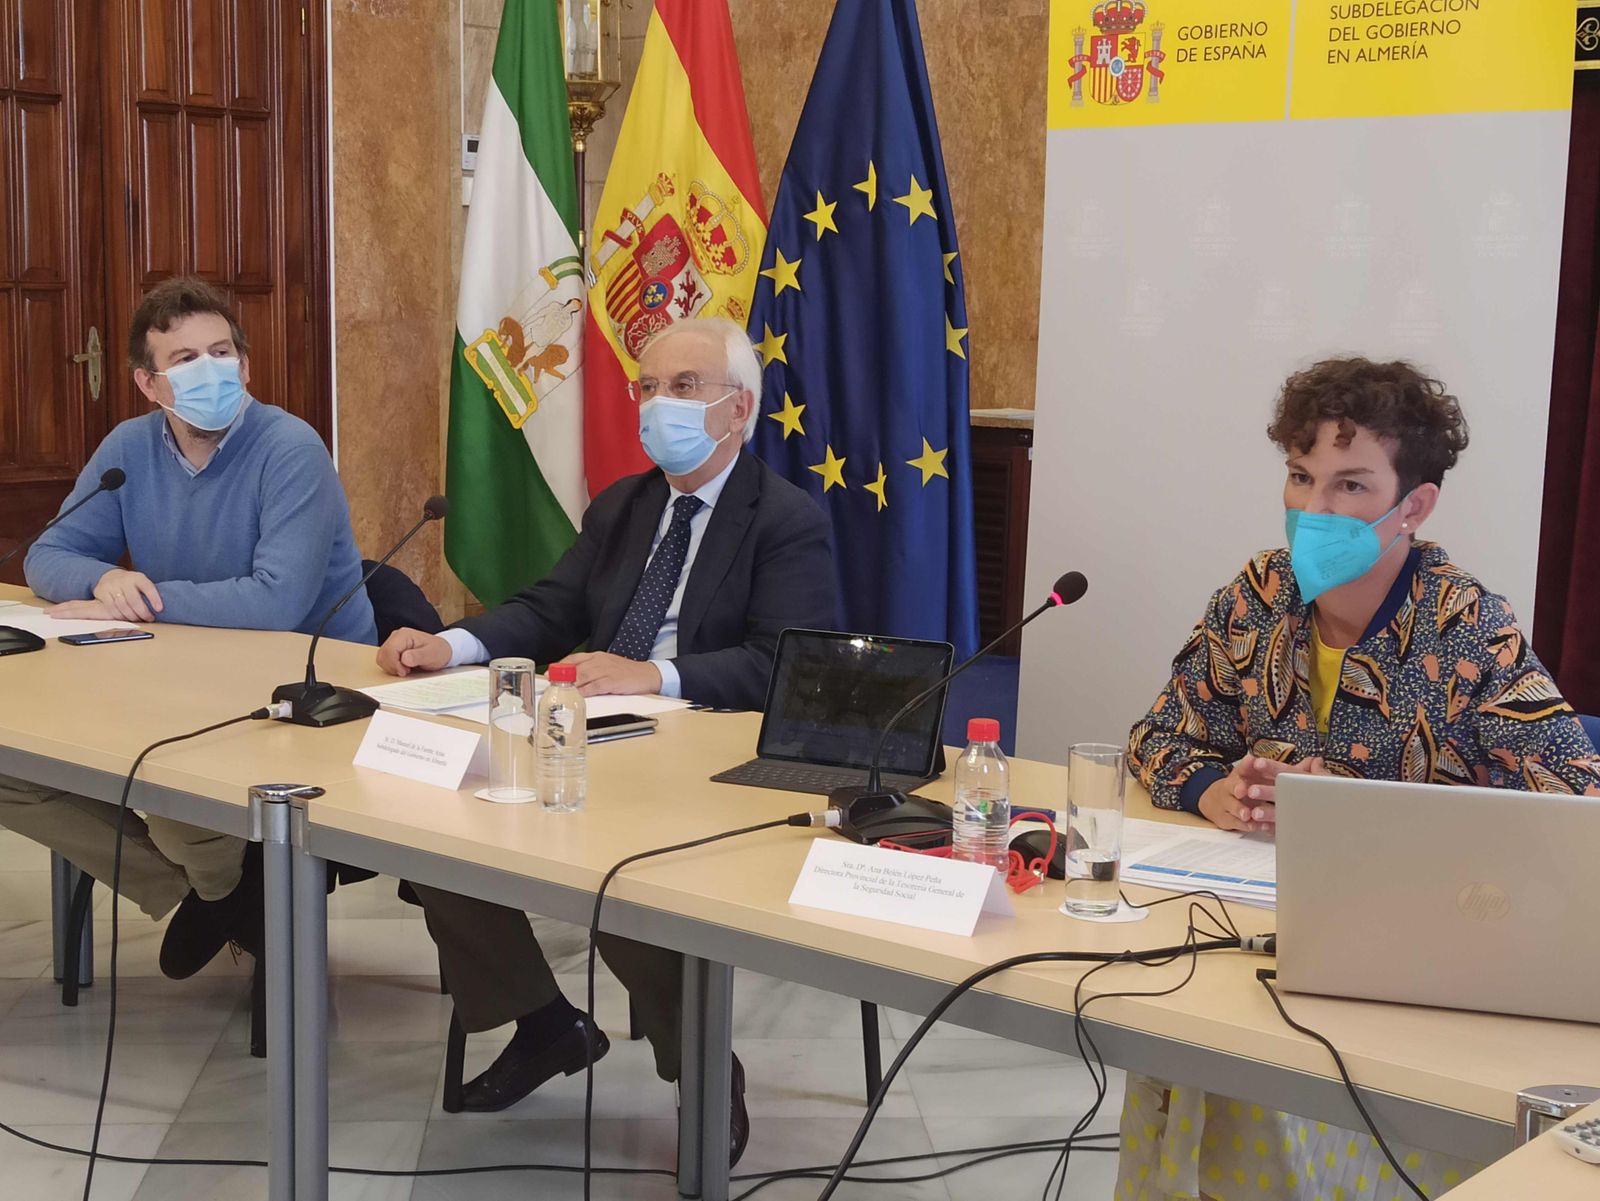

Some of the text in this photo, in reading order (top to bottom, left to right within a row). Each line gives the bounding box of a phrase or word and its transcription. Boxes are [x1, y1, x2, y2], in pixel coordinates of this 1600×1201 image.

[1177, 21, 1268, 41] GOBIERNO
[1329, 19, 1461, 42] DEL GOBIERNO
[1176, 48, 1198, 63] DE
[1203, 40, 1267, 61] ESPAÑA
[1327, 41, 1428, 64] EN ALMERÍA
